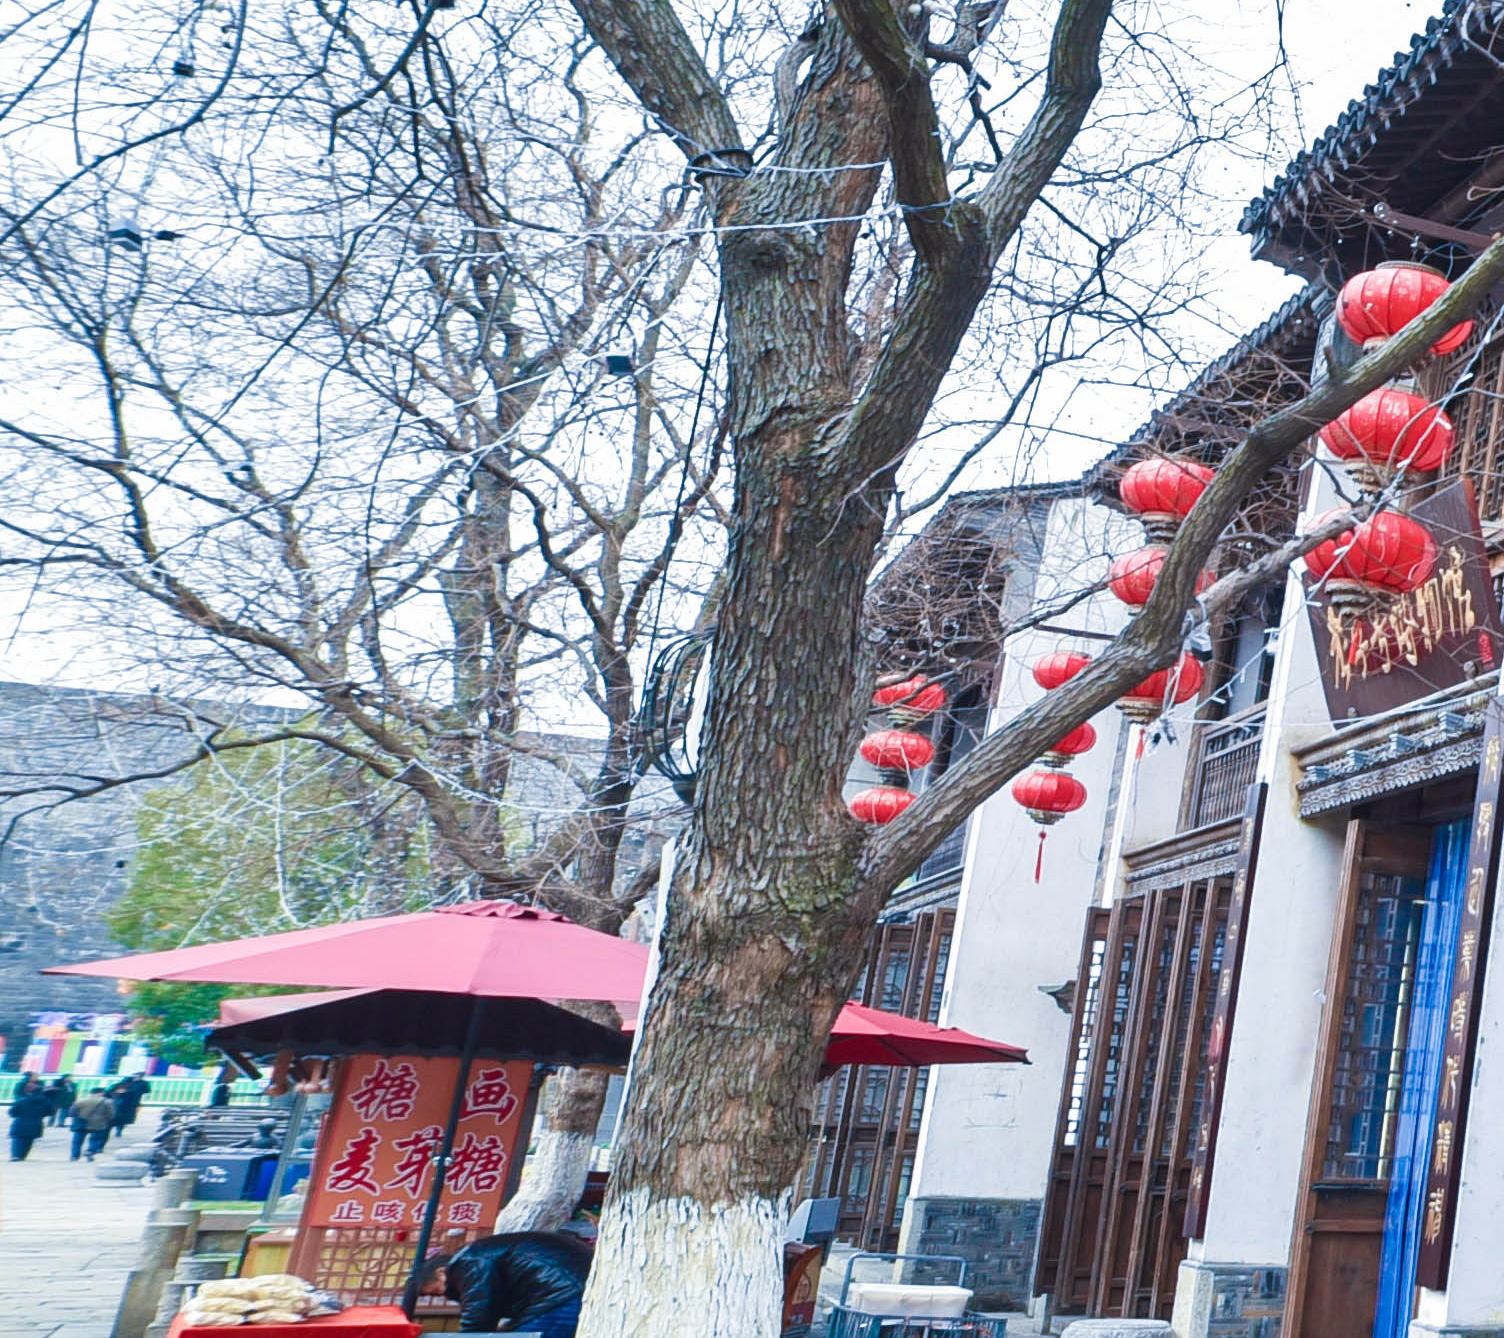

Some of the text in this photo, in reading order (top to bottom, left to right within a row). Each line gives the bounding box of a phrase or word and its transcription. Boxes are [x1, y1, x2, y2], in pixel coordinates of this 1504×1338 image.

[348, 1059, 518, 1125] 糖画
[326, 1125, 508, 1199] 麦芽糖
